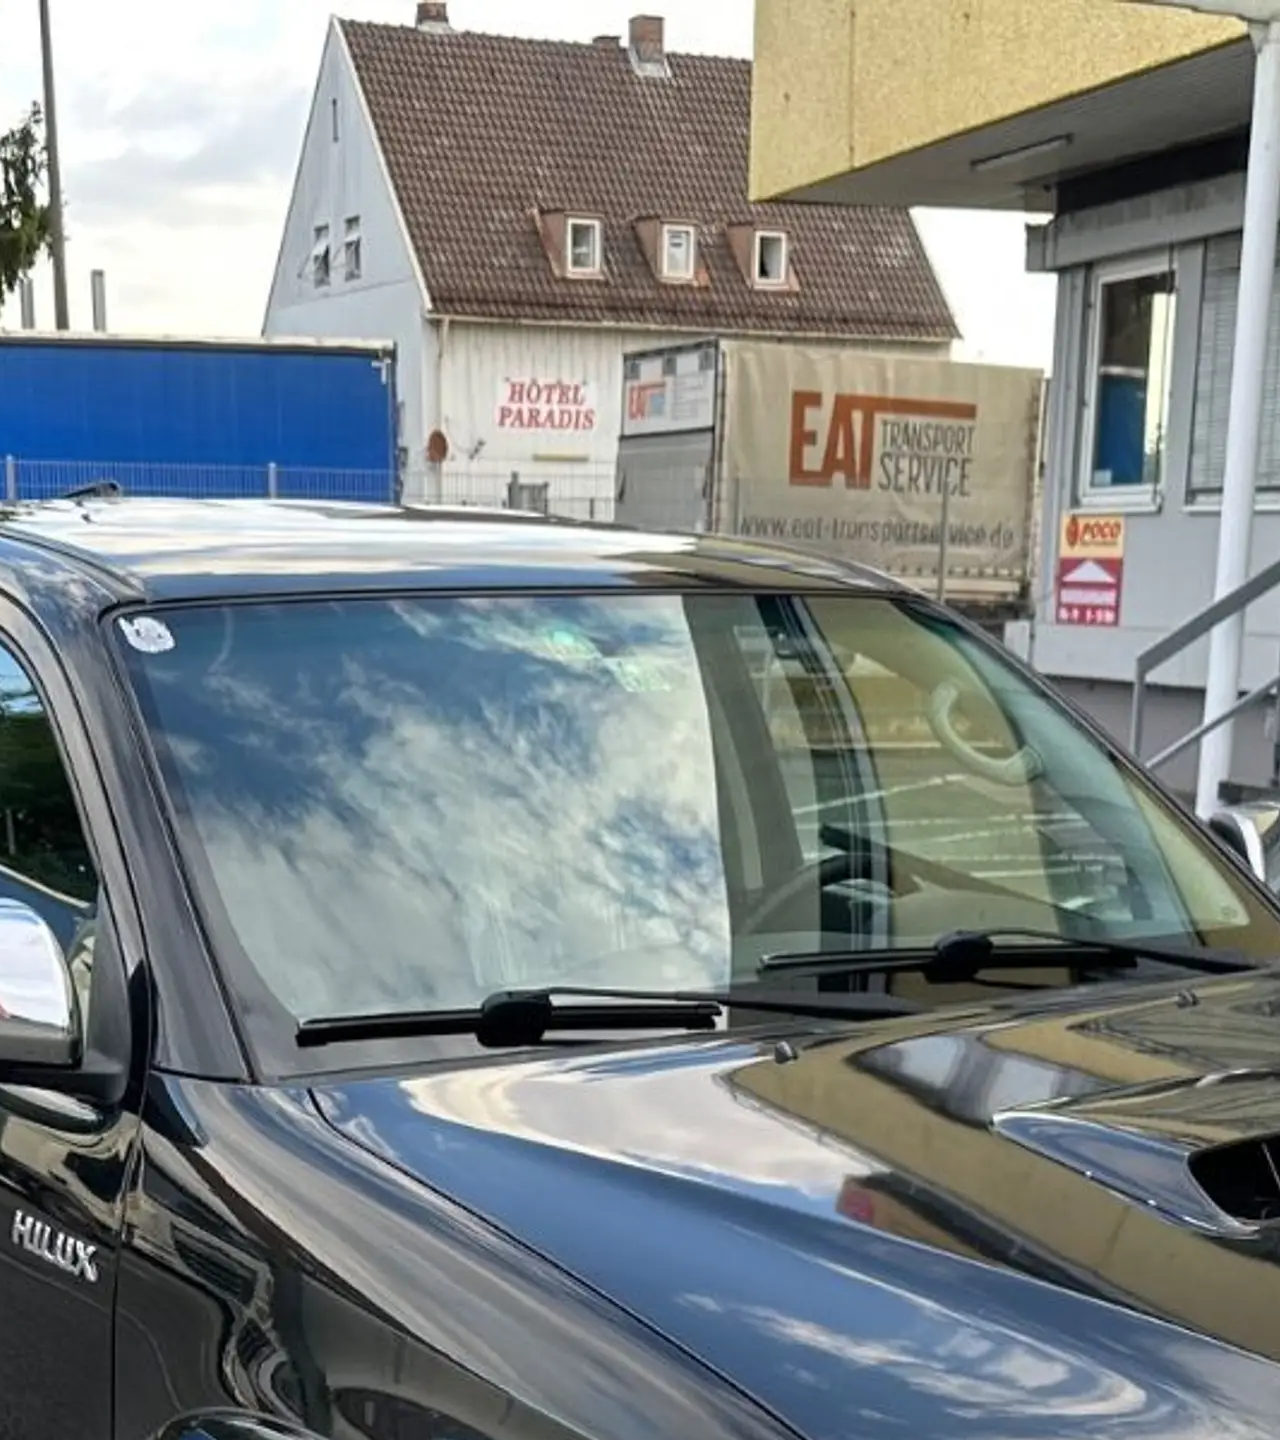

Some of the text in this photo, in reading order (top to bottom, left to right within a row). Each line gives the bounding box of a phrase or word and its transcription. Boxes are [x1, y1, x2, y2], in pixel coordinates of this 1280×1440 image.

[498, 406, 596, 430] PARADIS
[881, 419, 975, 455] TRANSPORT
[878, 451, 974, 497] SERVICE
[740, 516, 1014, 550] www.eat-transportsevice.de
[11, 1209, 99, 1283] HILUX
